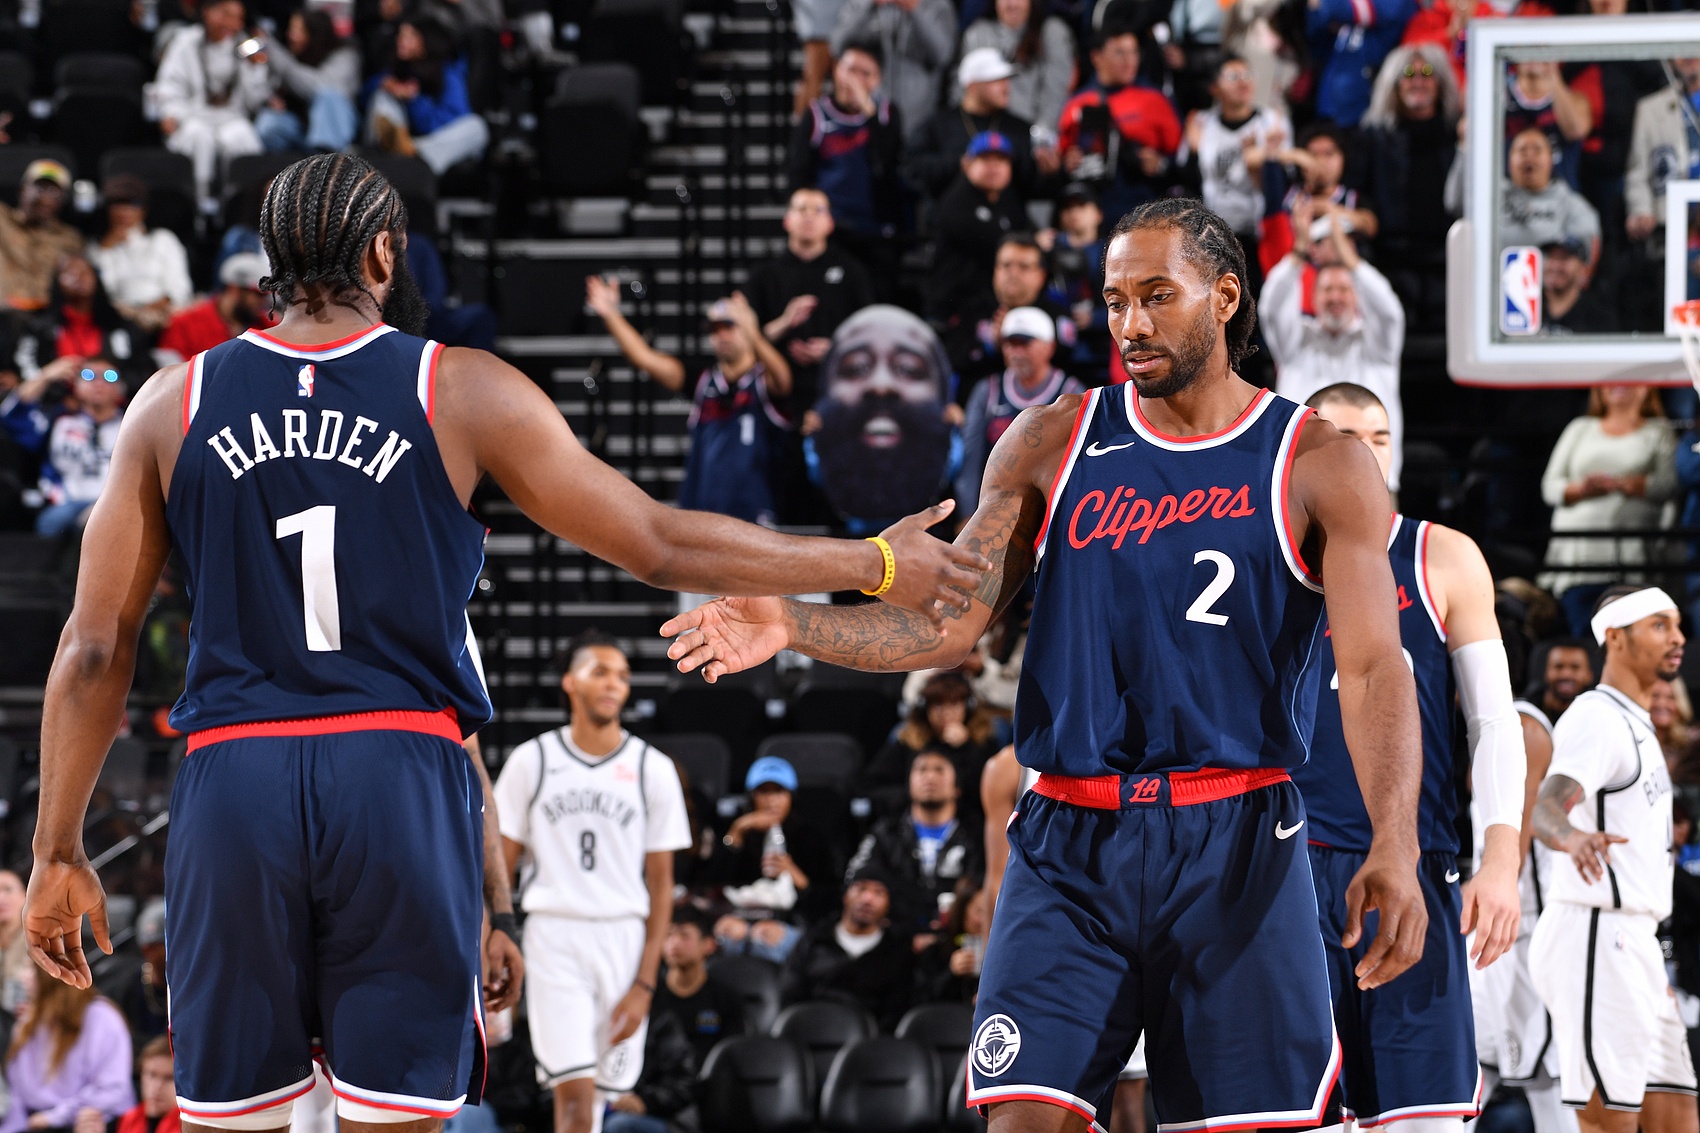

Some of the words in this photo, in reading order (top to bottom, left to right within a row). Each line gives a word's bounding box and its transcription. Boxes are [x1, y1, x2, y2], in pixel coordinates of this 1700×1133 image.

[207, 409, 412, 484] HARDEN
[1068, 484, 1256, 550] Clippers
[275, 505, 342, 652] 1
[1185, 549, 1236, 627] 2
[541, 787, 637, 829] BROOKLYN
[1128, 777, 1161, 803] LA
[580, 829, 596, 872] 8
